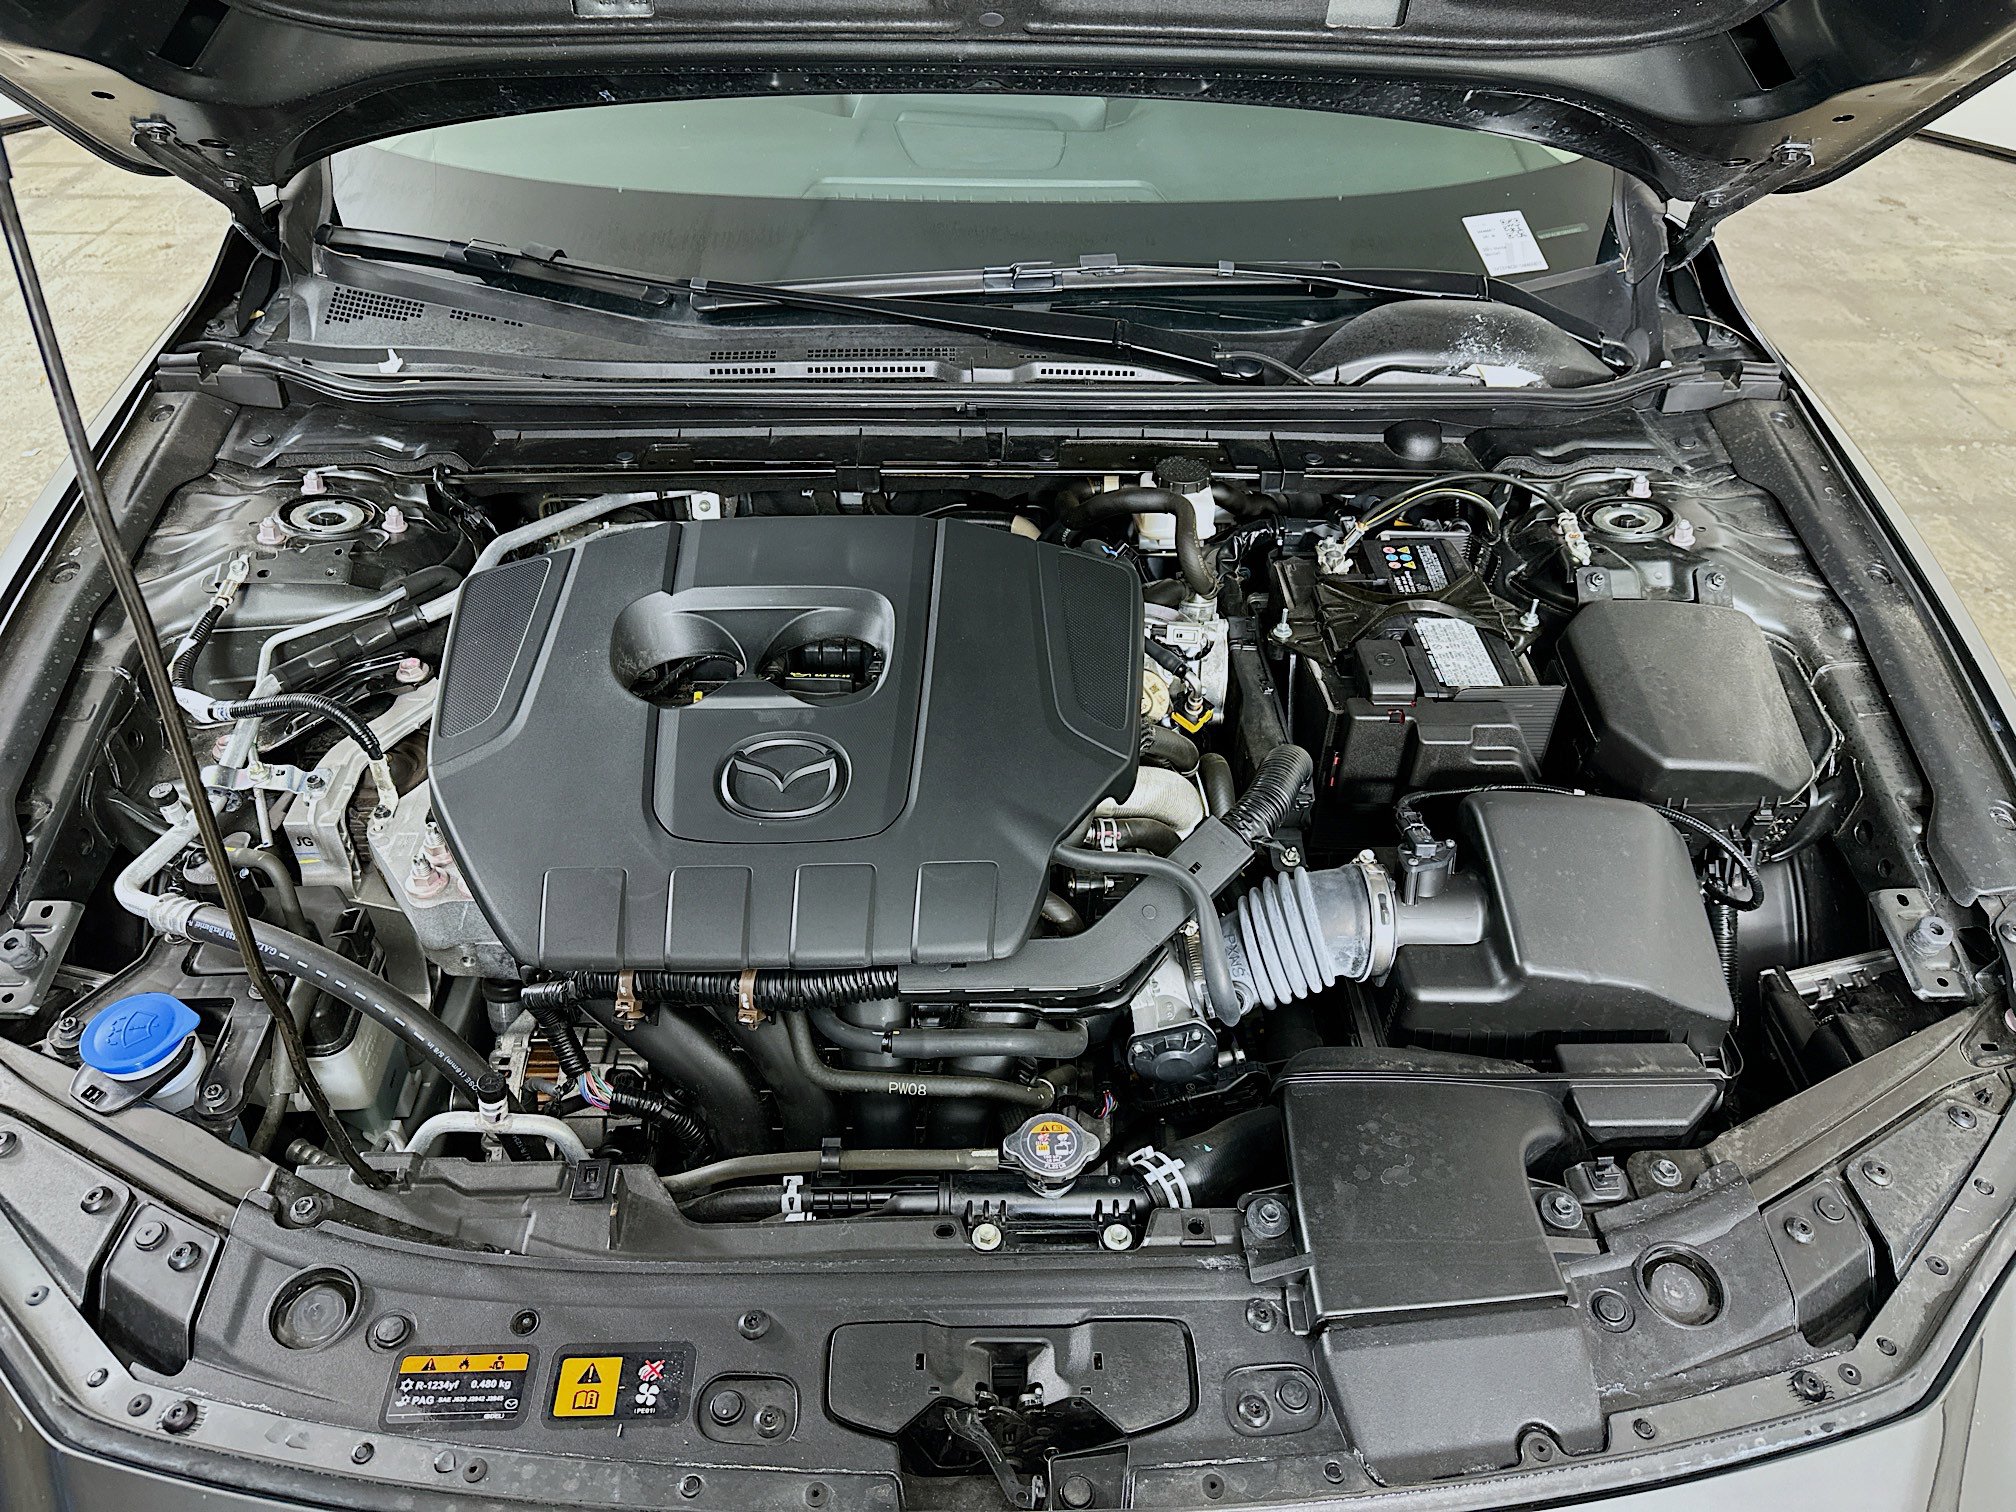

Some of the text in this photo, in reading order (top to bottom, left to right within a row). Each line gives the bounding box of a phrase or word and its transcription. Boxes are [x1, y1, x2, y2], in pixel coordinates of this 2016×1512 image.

[464, 1076, 478, 1091] OSE
[888, 1081, 927, 1096] PW08
[415, 1379, 512, 1391] R-1234yf 0.480 kg
[411, 1395, 435, 1405] PAG
